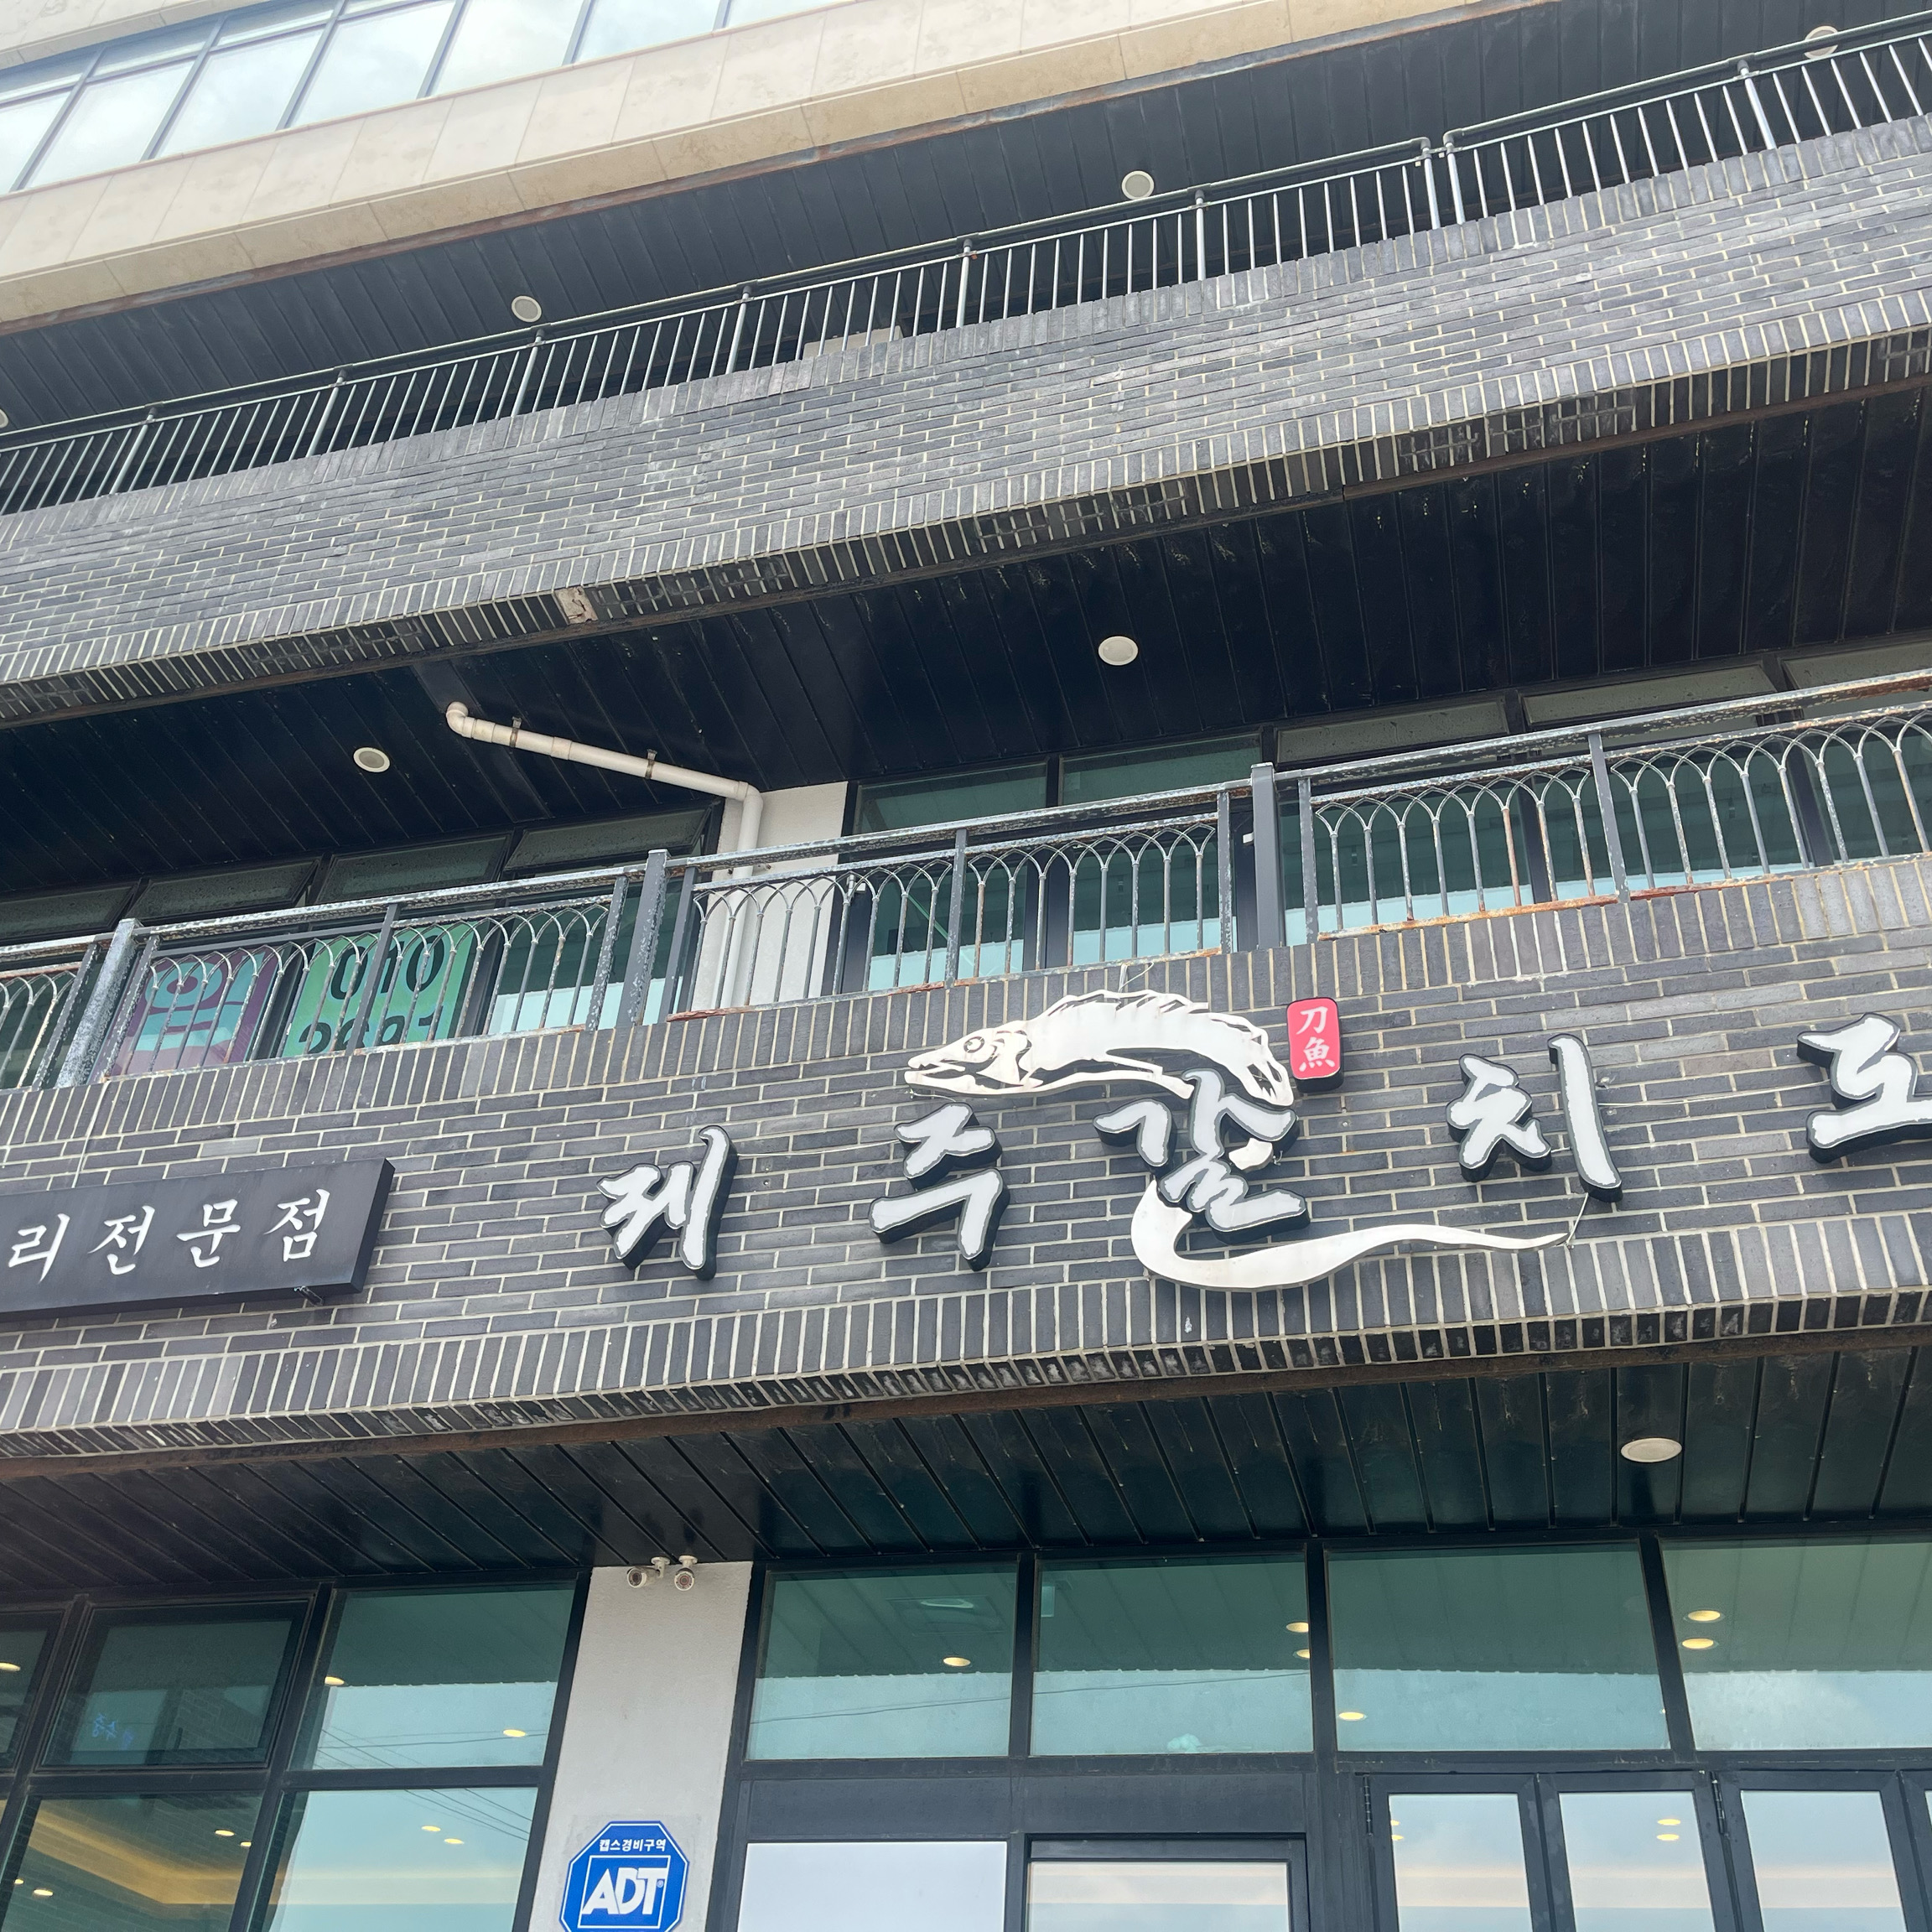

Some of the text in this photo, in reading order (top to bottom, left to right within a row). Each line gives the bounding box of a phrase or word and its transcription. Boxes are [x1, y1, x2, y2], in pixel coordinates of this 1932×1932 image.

[330, 934, 445, 1000] 010
[1296, 1005, 1336, 1072] 刀魚
[8, 1187, 331, 1284] 리전문점
[581, 1867, 668, 1915] ADT
